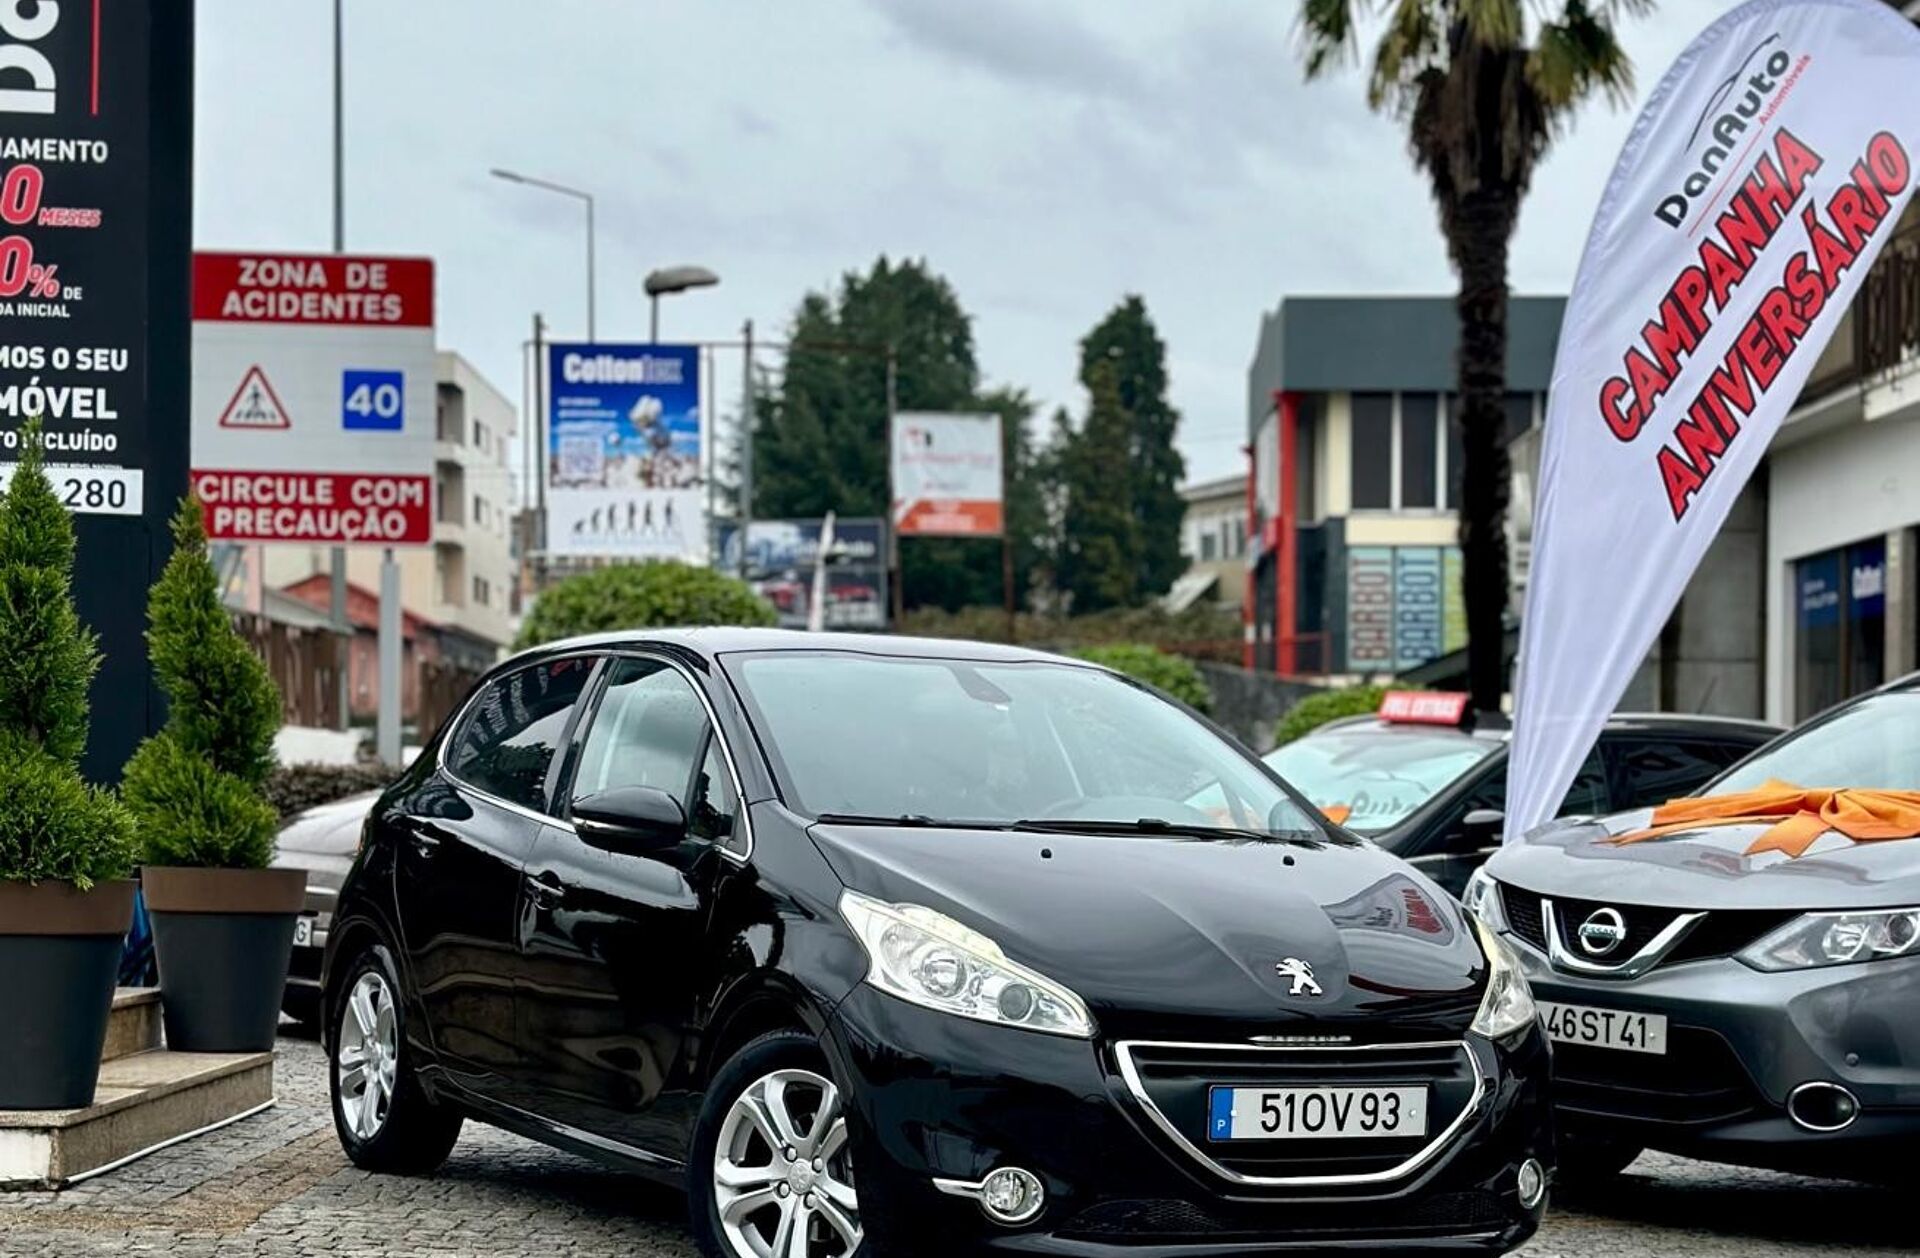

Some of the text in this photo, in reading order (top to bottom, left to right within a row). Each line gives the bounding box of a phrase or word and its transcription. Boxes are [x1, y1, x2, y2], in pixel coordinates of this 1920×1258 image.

[1653, 50, 1790, 229] DanAuto
[38, 207, 102, 228] MESES
[238, 260, 388, 290] ZONA DE
[1599, 125, 1825, 443] CAMPANHA
[63, 286, 83, 300] DE
[221, 290, 403, 321] ACIDENTES
[17, 303, 71, 318] INICIAL
[1656, 130, 1911, 524] ANIVERSÁRIO
[52, 347, 70, 370] O
[76, 348, 129, 372] SEU
[346, 383, 401, 418] 40
[63, 477, 126, 508] 280
[198, 475, 423, 506] CIRCULE COM
[213, 506, 407, 541] PRECAUÇÃO
[1217, 1118, 1226, 1131] P
